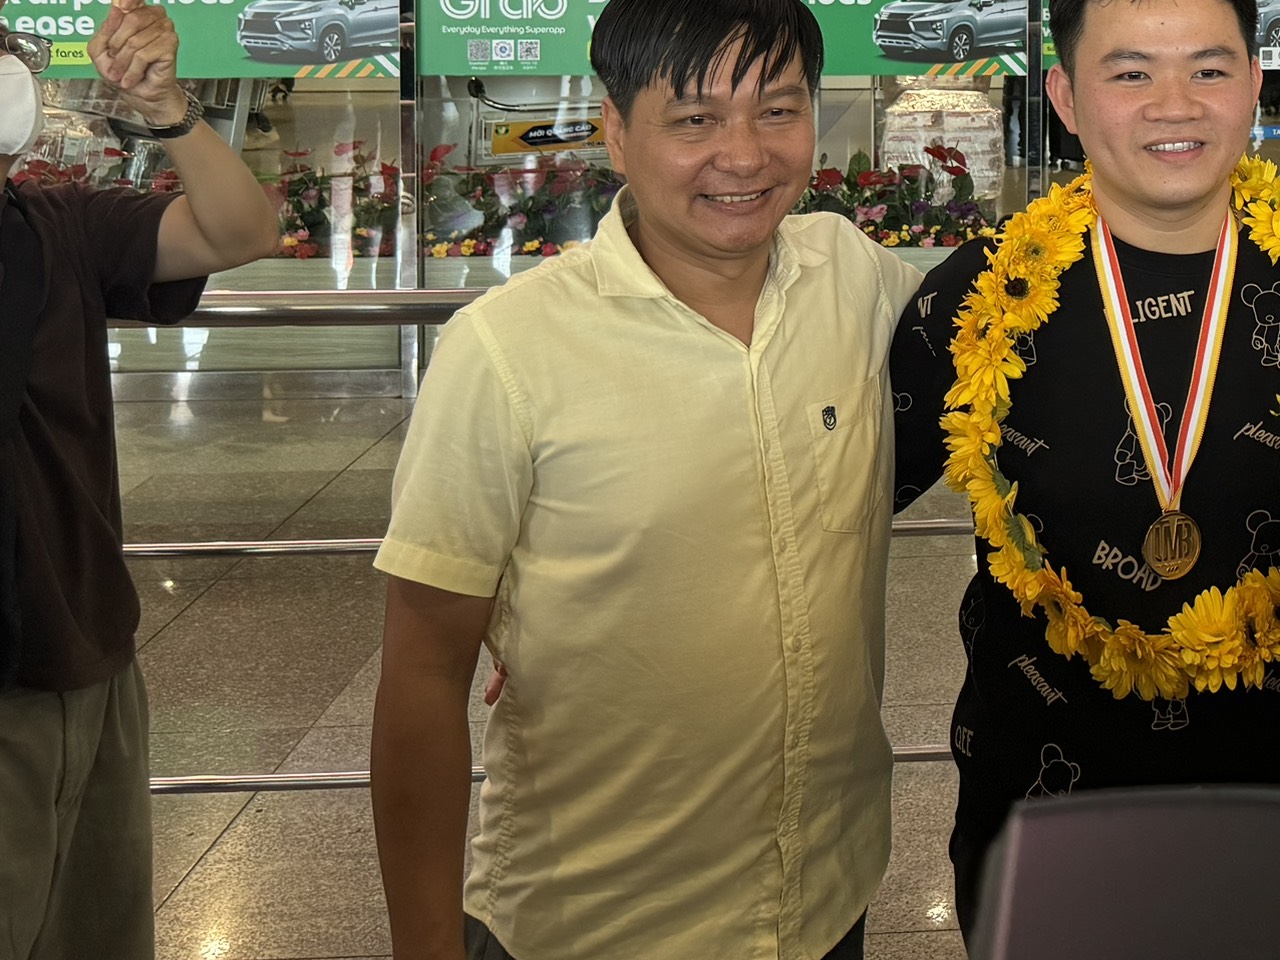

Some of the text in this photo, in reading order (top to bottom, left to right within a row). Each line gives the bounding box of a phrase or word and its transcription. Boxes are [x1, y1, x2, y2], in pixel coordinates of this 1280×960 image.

[15, 15, 95, 36] ease
[442, 25, 566, 35] Everyday Everything Superapp
[55, 48, 85, 59] fares
[1092, 540, 1163, 592] BROAD
[1007, 654, 1068, 707] pleasant
